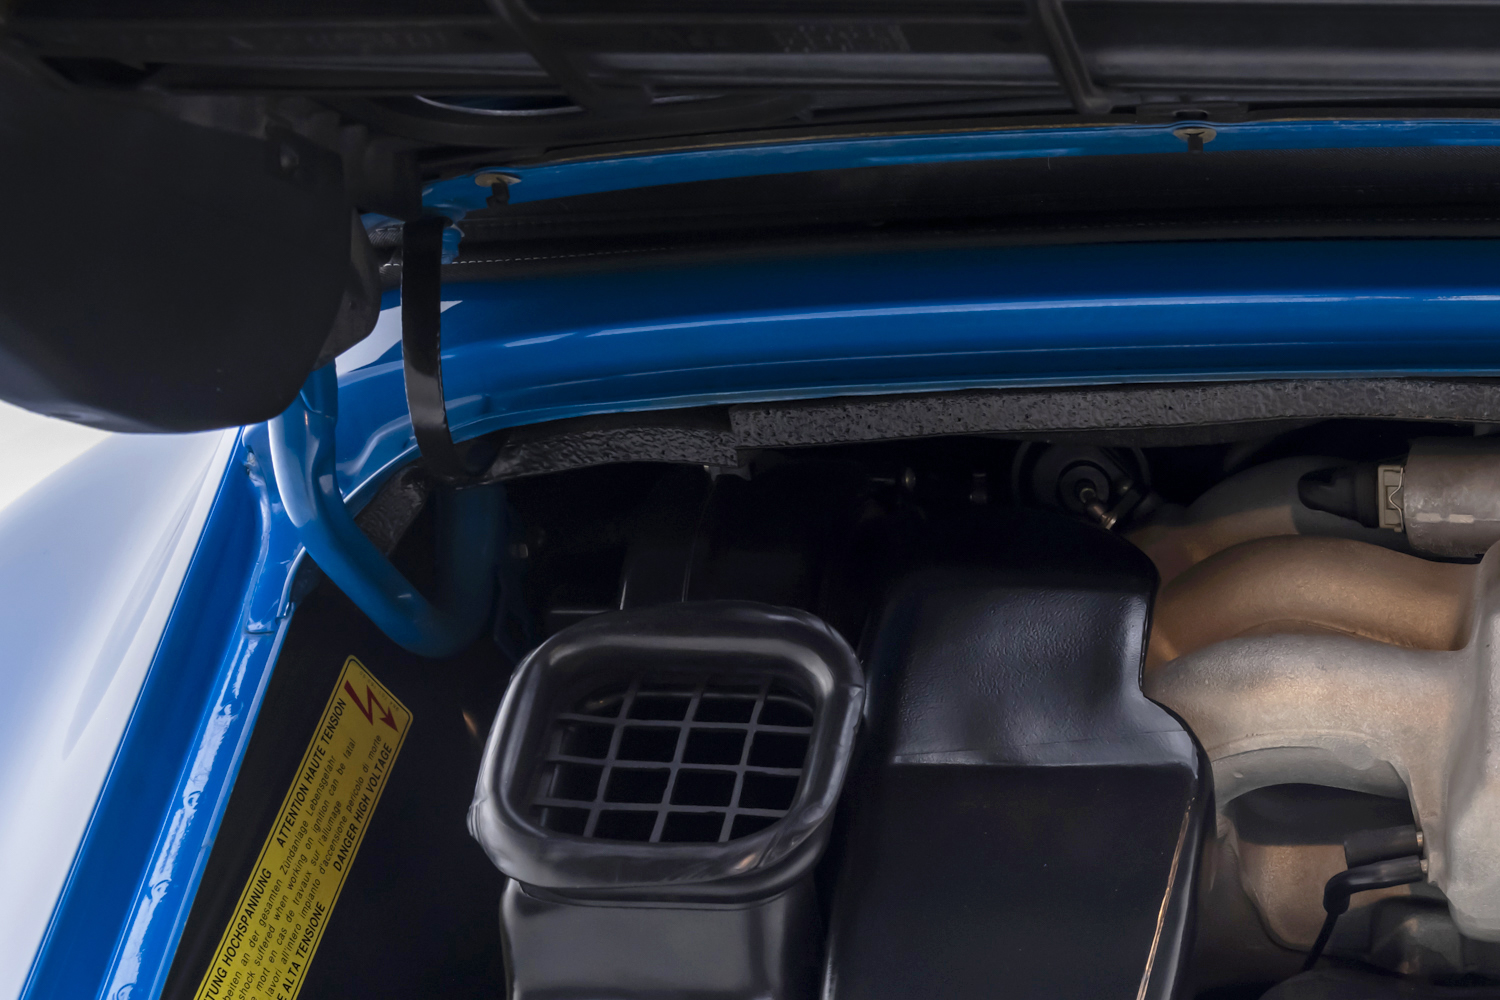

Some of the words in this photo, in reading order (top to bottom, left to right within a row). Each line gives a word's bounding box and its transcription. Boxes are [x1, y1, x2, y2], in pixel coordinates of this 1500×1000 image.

[222, 867, 272, 967] HOCHSPANNUNG
[276, 784, 309, 848] ATTENTION
[304, 742, 327, 785] HAUTE
[322, 698, 346, 743] TENSION
[238, 971, 256, 1000] shock
[254, 925, 275, 967] suffered
[274, 895, 288, 921] when
[287, 853, 308, 890] working
[305, 837, 314, 850] on
[312, 800, 330, 833] ignition
[328, 779, 339, 796] can
[336, 763, 346, 776] be
[343, 737, 356, 760] fatal
[284, 962, 301, 994] ALTA
[295, 901, 325, 959] TENSIONE
[333, 823, 359, 872] DANGER
[353, 793, 371, 823] HIGH
[366, 742, 392, 793] VOLTAGE
